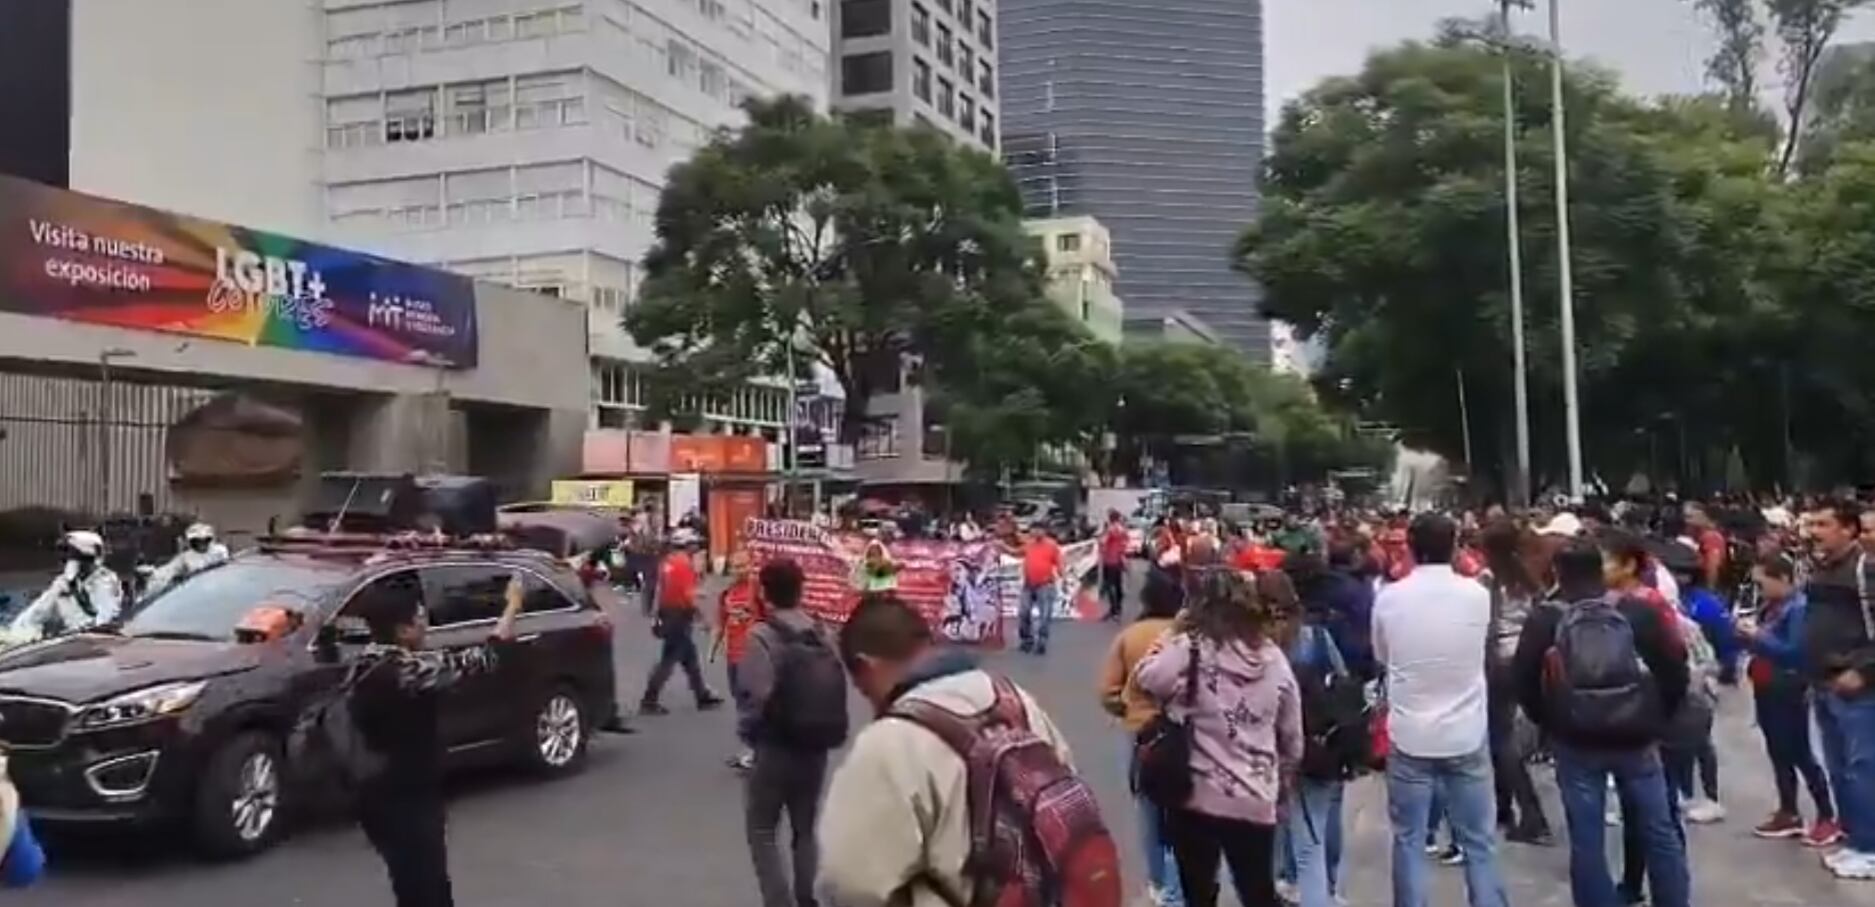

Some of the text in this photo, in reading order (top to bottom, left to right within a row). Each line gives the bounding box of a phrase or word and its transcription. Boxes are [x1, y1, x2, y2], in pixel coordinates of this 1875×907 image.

[29, 219, 164, 264] Visita nuestra
[216, 247, 326, 299] LGBT+
